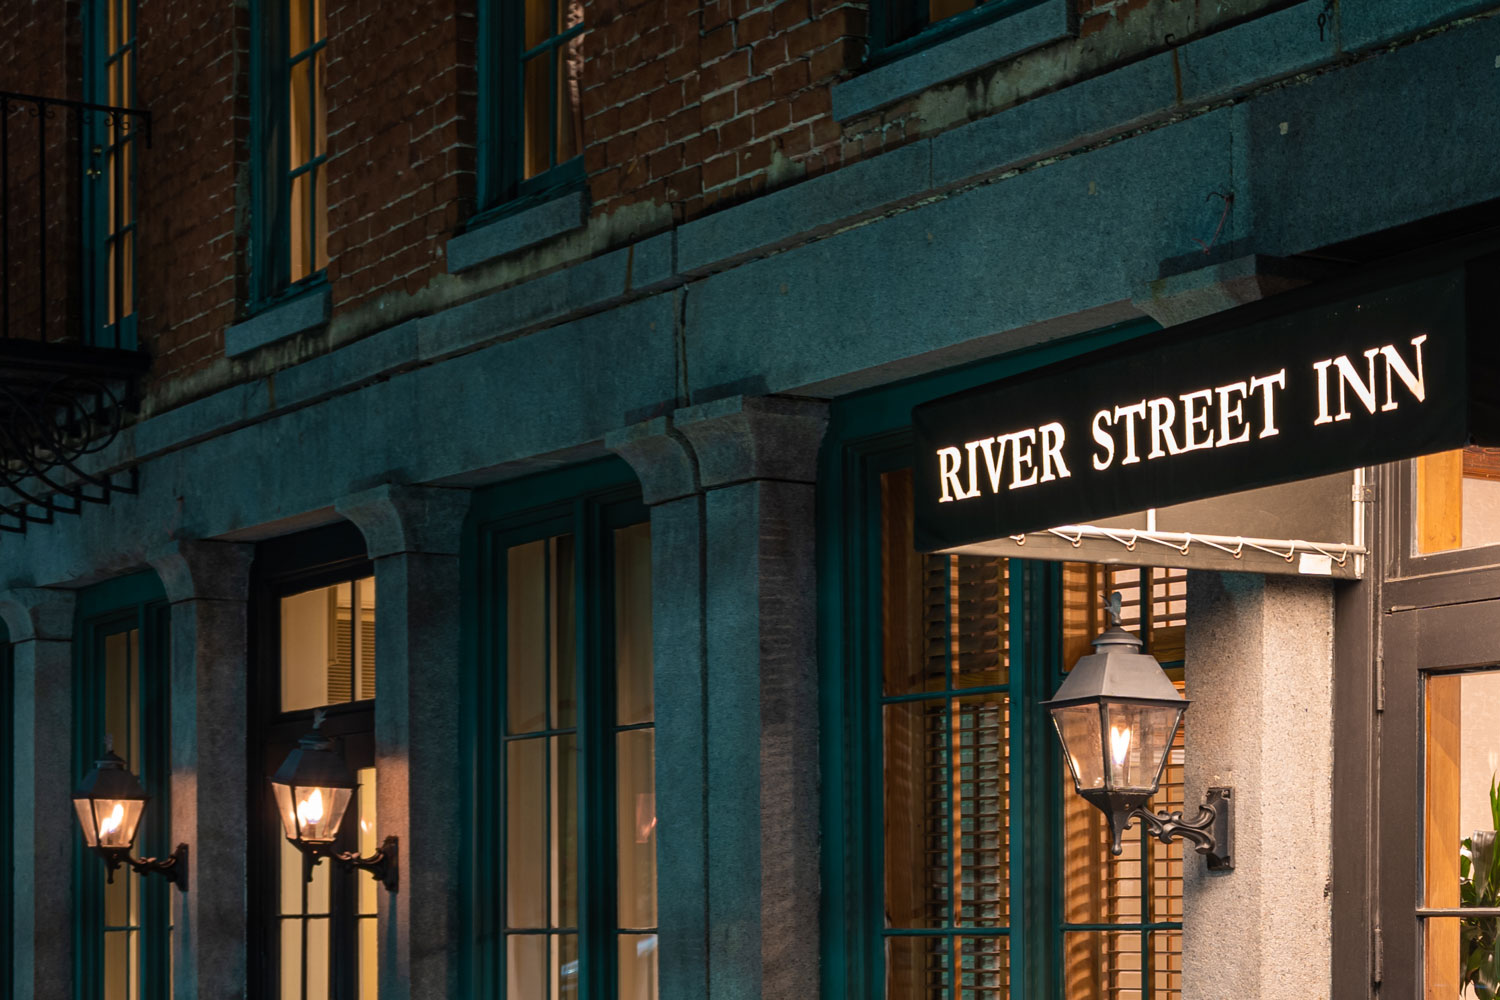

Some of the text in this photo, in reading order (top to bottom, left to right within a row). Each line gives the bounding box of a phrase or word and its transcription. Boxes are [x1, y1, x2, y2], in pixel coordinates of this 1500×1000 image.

[937, 334, 1426, 502] RIVER STREET INN
